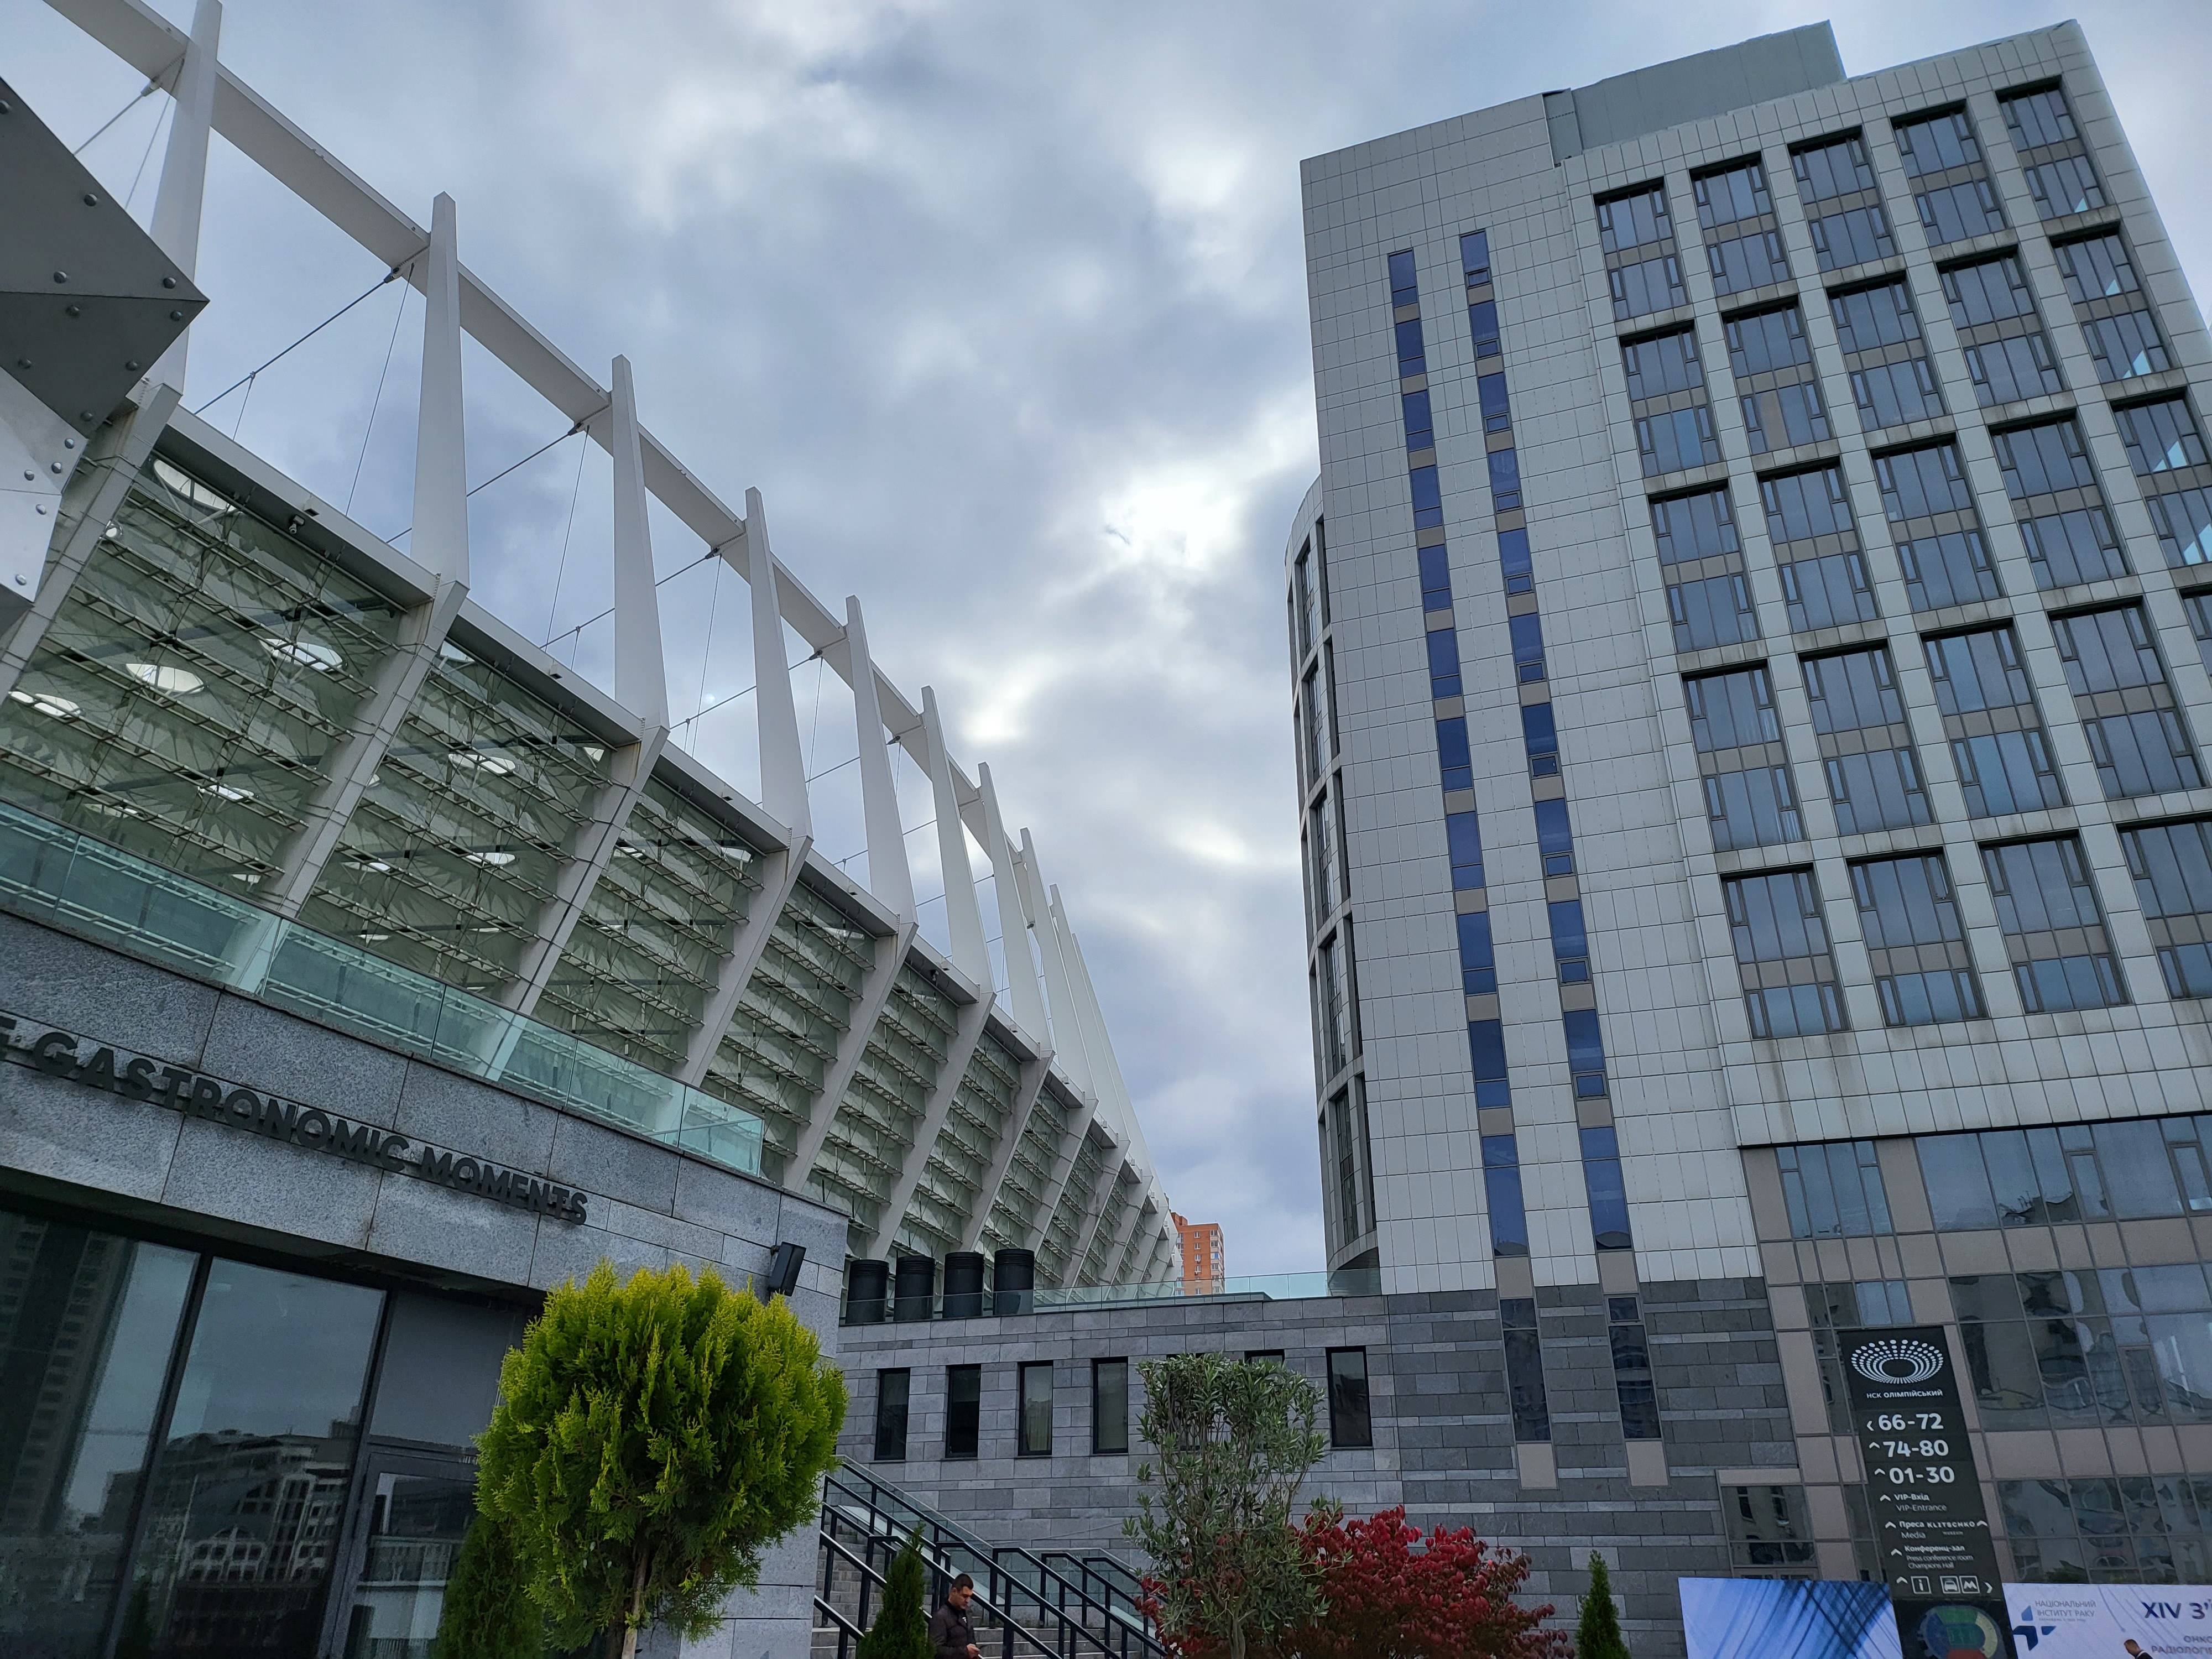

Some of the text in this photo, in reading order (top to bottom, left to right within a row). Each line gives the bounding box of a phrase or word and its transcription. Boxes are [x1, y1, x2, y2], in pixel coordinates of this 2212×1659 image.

[33, 1032, 409, 1172] GASTRONOMIC
[420, 1146, 588, 1225] MOMENTS
[1883, 1389, 1943, 1398] ОЛІМПІЙСЬКИЙ
[1878, 1413, 1944, 1431] 66-72
[1883, 1439, 1949, 1458] 74-80
[1889, 1466, 1955, 1484] 01-30
[1899, 1521, 1925, 1529] Преса
[2141, 1601, 2181, 1619] XIV
